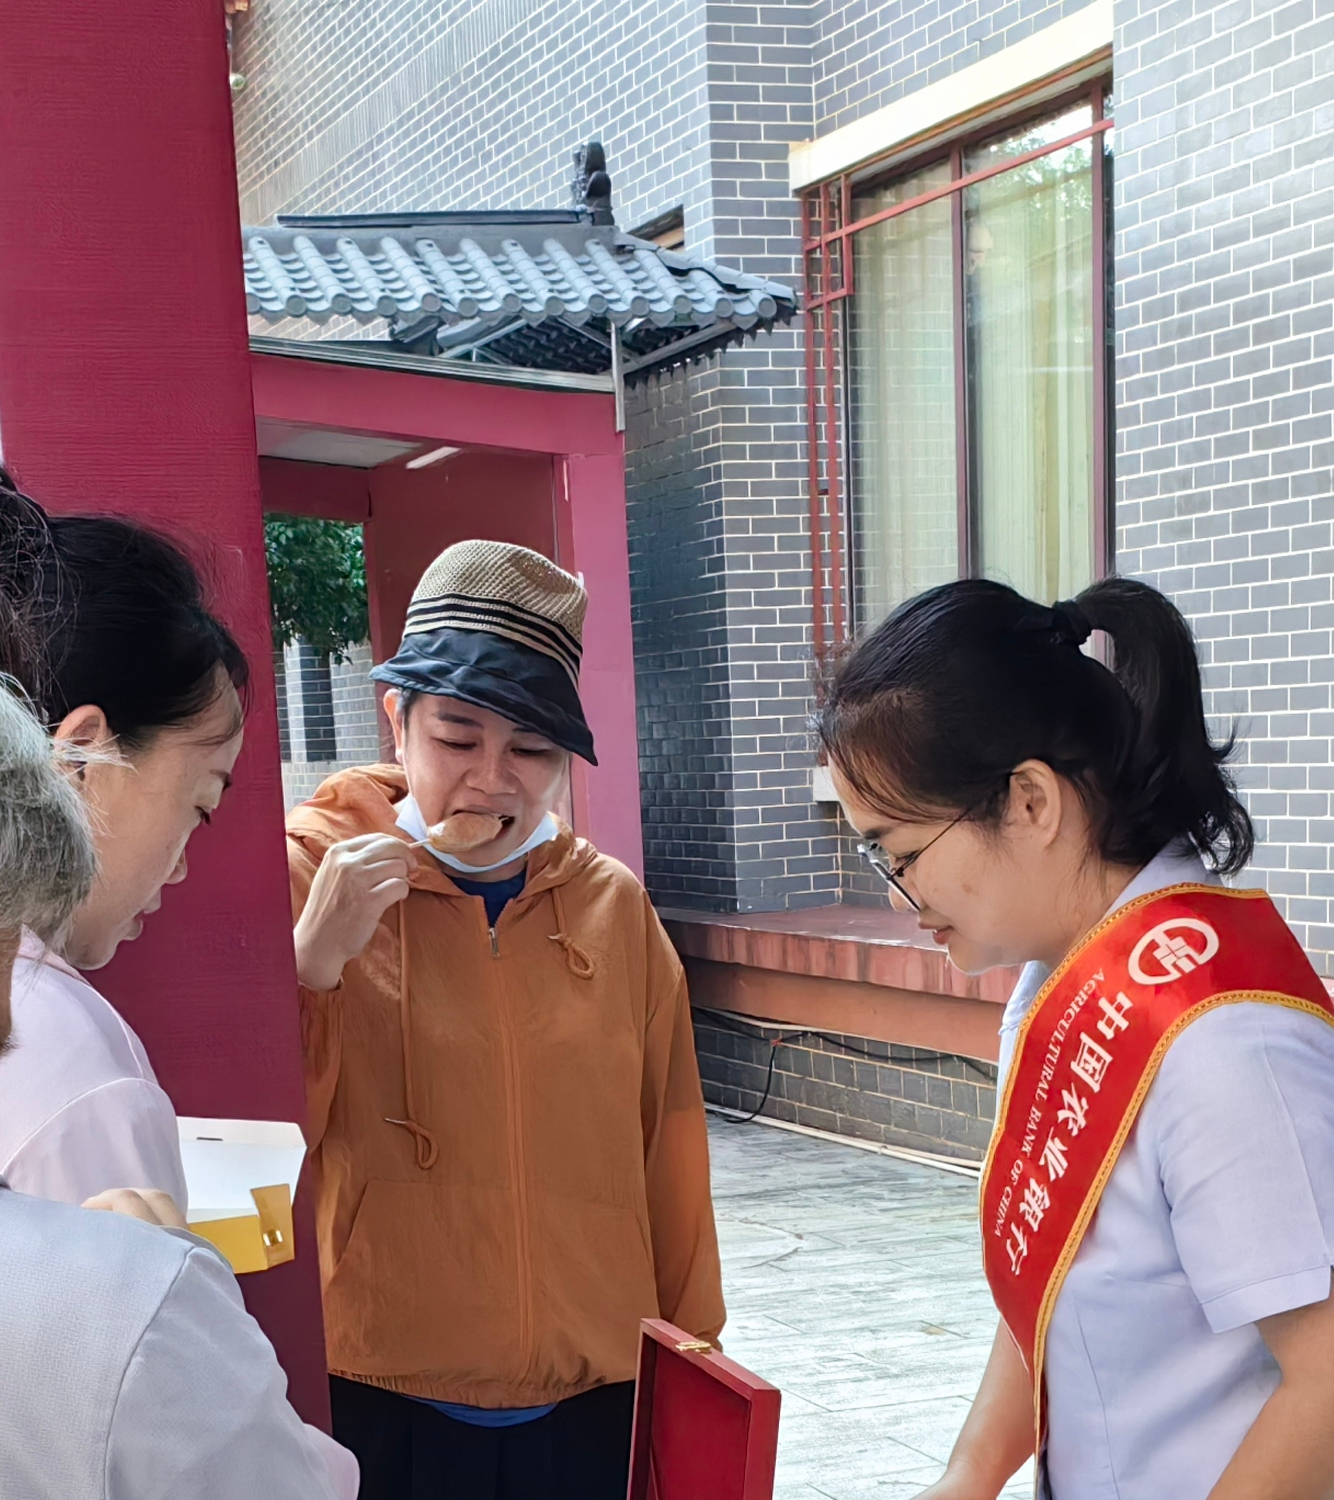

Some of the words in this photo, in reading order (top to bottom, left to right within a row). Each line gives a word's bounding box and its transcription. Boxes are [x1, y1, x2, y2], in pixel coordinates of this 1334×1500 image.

[1033, 968, 1105, 1103] AGRICULTURAL
[1009, 991, 1133, 1276] 中国农业银行
[1020, 1103, 1043, 1158] BANK
[1010, 1159, 1024, 1181] OF
[994, 1181, 1014, 1238] CHINA
